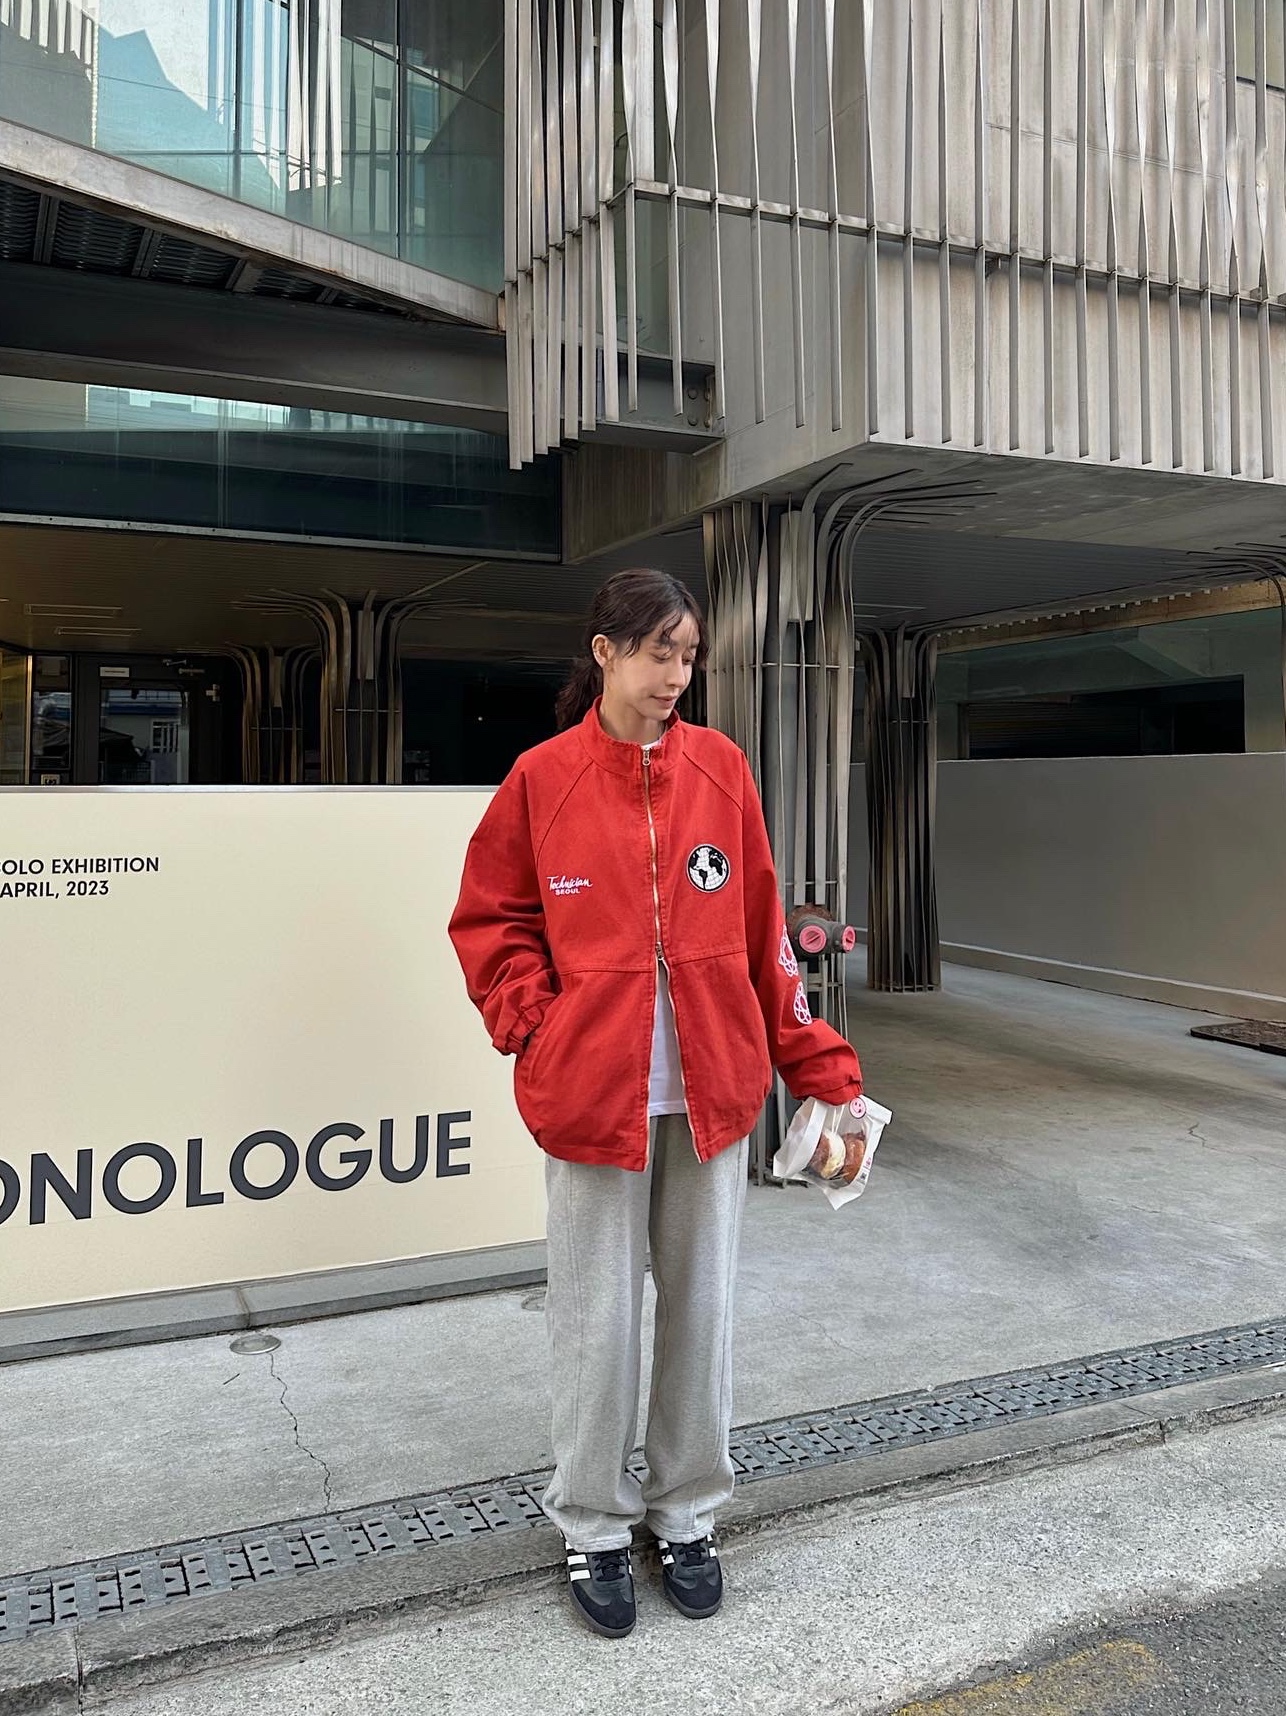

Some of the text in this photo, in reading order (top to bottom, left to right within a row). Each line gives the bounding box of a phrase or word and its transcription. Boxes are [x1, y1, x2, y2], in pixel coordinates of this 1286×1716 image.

[0, 857, 159, 875] OLO EXHIBITION
[0, 880, 109, 899] APRIL, 2023
[546, 875, 594, 891] Technician
[555, 888, 581, 896] SEOUL
[0, 1110, 472, 1225] NOLOGUE
